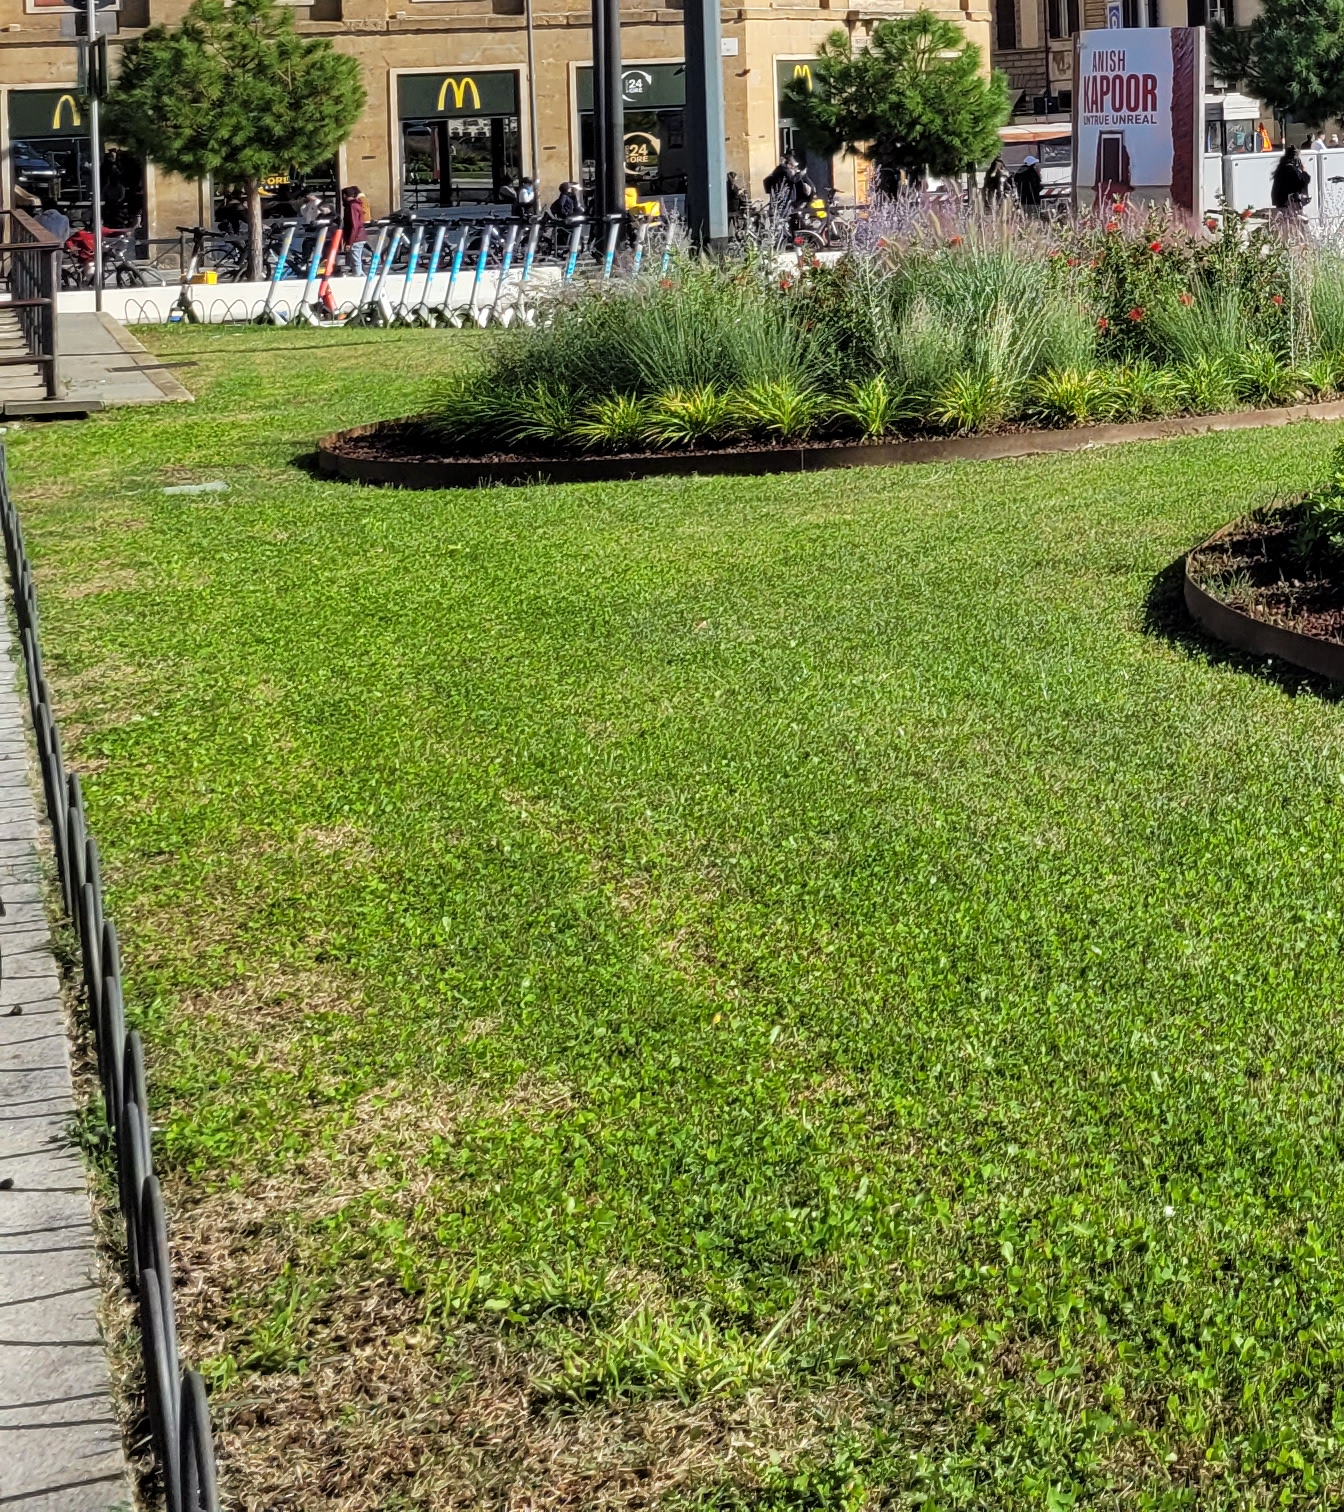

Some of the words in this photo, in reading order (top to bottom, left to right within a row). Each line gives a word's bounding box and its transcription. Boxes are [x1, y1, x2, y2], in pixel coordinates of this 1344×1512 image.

[1092, 50, 1126, 73] ANISH
[628, 79, 643, 89] 24
[1083, 74, 1158, 113] KAPOOR
[1083, 115, 1110, 126] UNTRUE
[1112, 114, 1158, 125] UNREAL
[630, 144, 648, 156] 24
[630, 155, 649, 163] ORE
